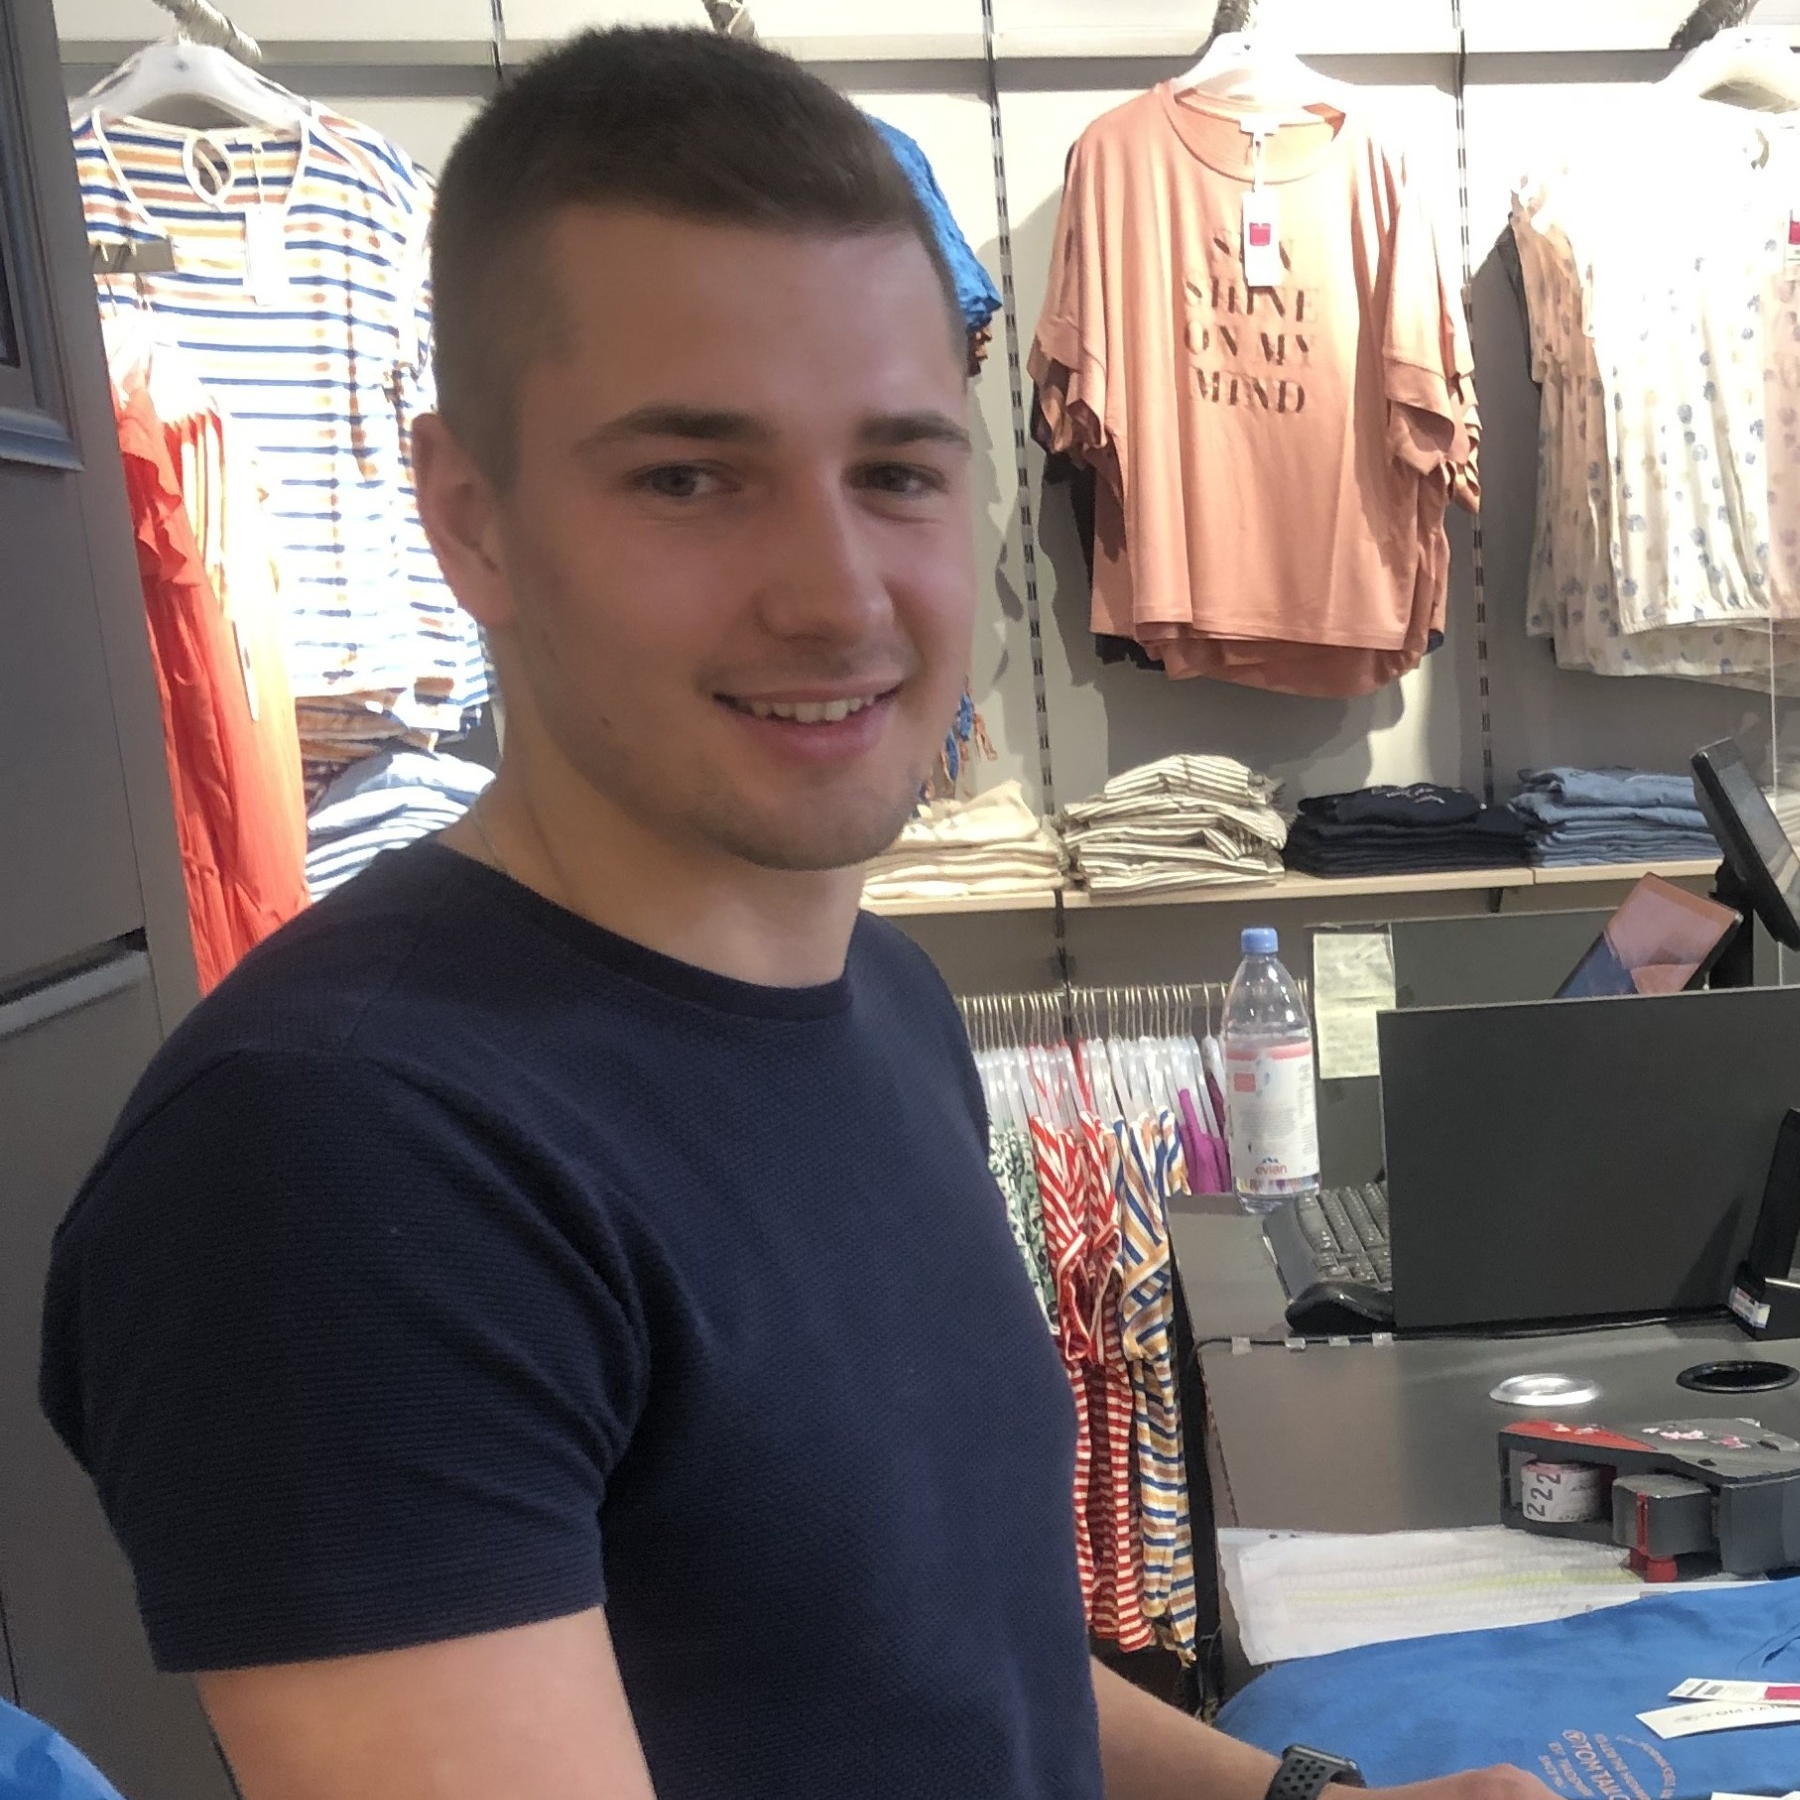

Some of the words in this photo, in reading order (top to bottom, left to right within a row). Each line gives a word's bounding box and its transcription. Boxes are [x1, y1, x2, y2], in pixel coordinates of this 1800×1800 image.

[1183, 320, 1241, 357] ON
[1195, 367, 1306, 414] MIND
[1255, 1164, 1288, 1176] evian
